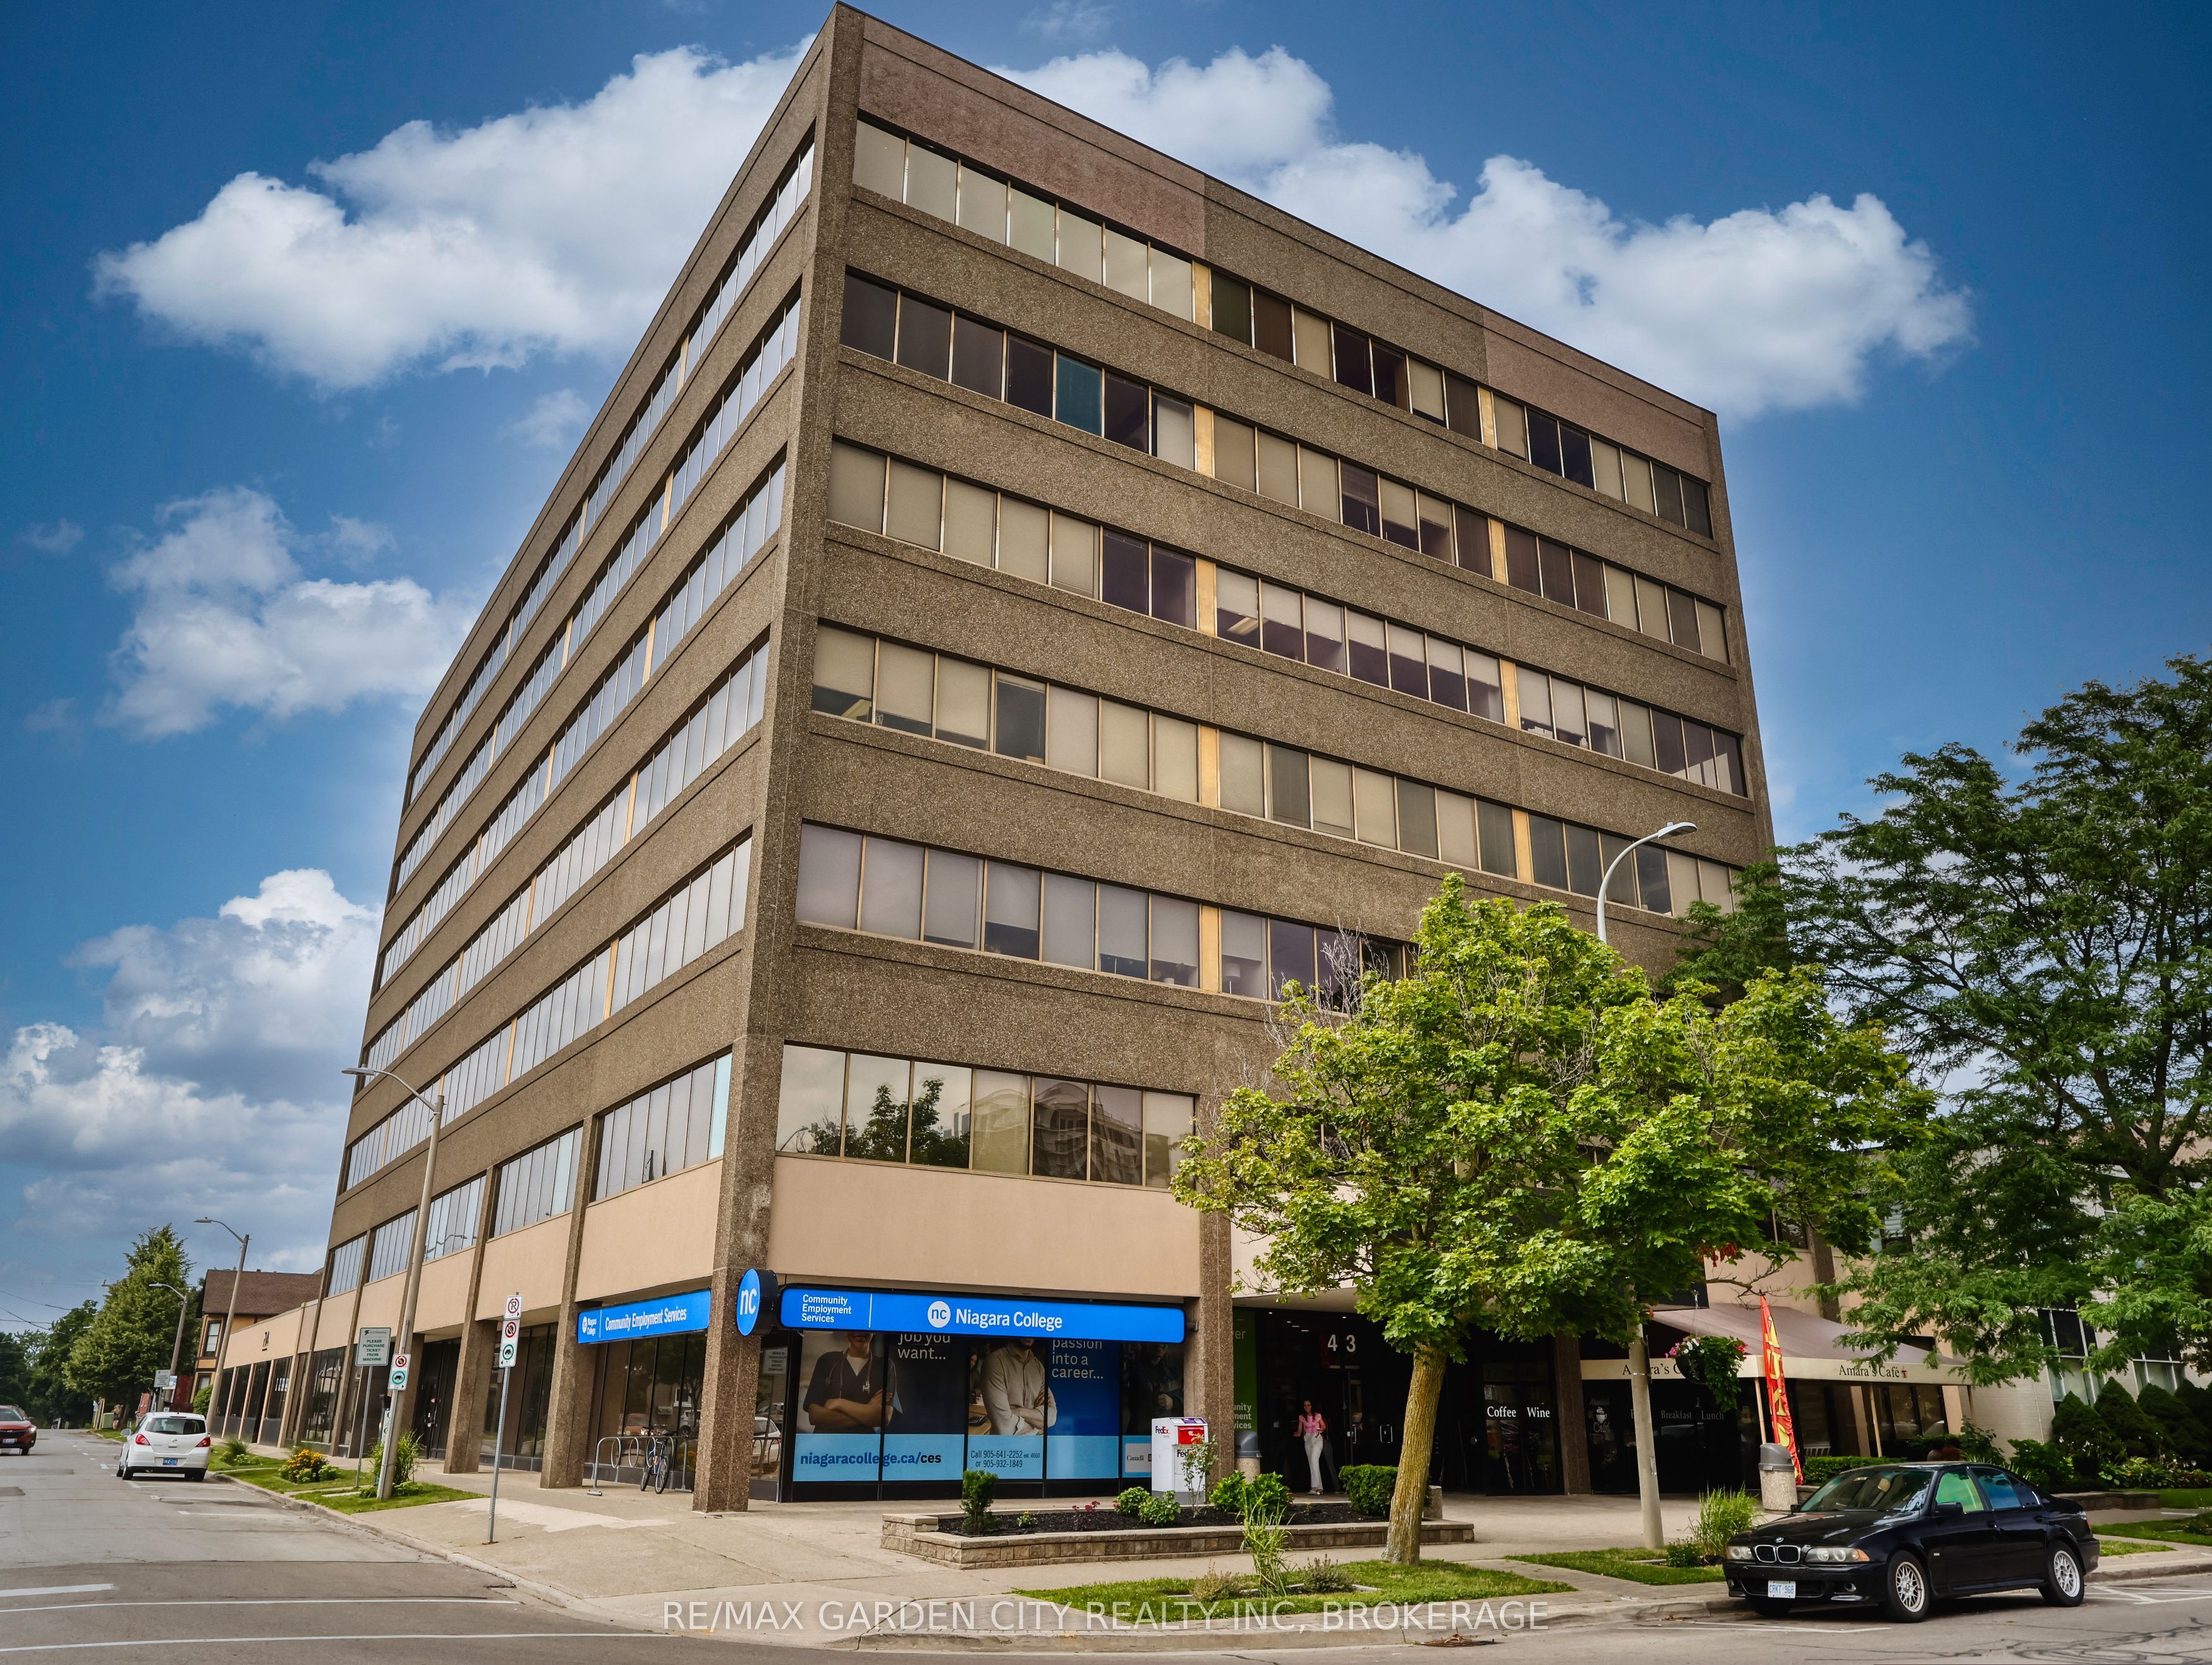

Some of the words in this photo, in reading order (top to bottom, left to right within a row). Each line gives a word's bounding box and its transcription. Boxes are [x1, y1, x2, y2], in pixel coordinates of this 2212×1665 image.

[740, 1288, 757, 1315] nc
[803, 1294, 848, 1306] Community
[802, 1304, 851, 1314] Employment
[605, 1314, 631, 1331] Community
[632, 1309, 662, 1329] Employment
[664, 1306, 686, 1323] Services
[802, 1314, 834, 1323] Services
[931, 1308, 947, 1320] nc
[956, 1308, 1009, 1328] Niagara
[1013, 1311, 1062, 1331] College
[925, 1335, 951, 1345] you
[897, 1347, 945, 1360] want...
[1052, 1352, 1078, 1364] into
[1081, 1356, 1088, 1365] a
[1052, 1368, 1103, 1379] career...
[1839, 1365, 1876, 1376] Amara's
[1878, 1366, 1900, 1377] Café
[1487, 1405, 1517, 1417] Coffee
[1527, 1407, 1550, 1418] Wine
[1661, 1410, 1692, 1419] Breakfast
[1701, 1410, 1724, 1420] Lunch
[1155, 1426, 1169, 1434] FedEx
[800, 1452, 941, 1467] niagaracollege.ca/ces
[983, 1450, 1023, 1458] 905-641-2252
